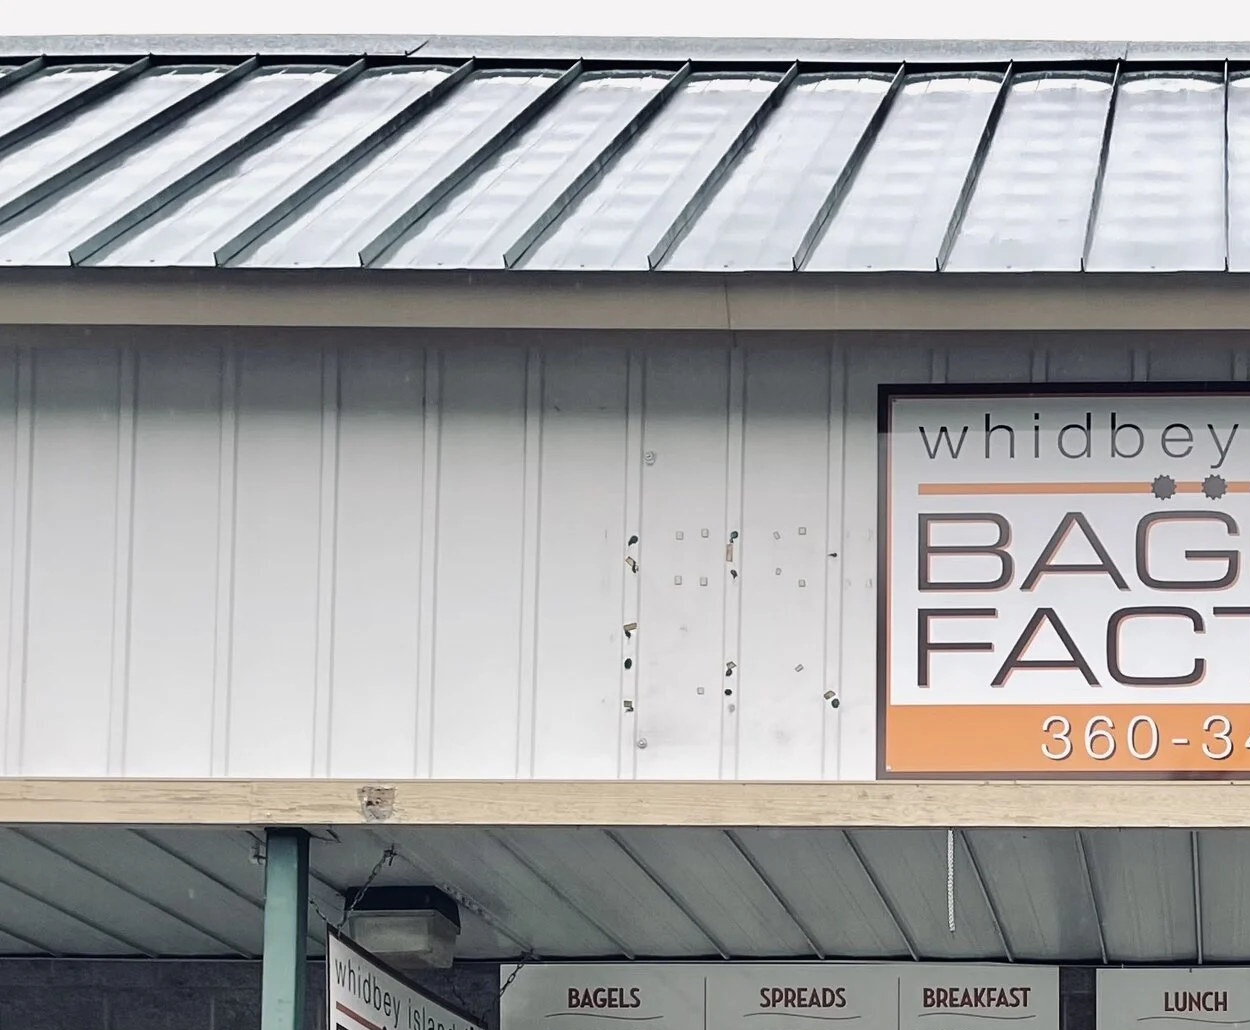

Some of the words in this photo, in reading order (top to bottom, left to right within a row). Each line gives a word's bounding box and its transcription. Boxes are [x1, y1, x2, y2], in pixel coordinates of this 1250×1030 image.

[919, 412, 1240, 469] whidbey
[335, 957, 400, 1028] whidbey
[568, 988, 641, 1008] BAGELS
[760, 988, 847, 1008] SPREADS
[923, 988, 1031, 1008] BREAKFAST
[1165, 991, 1227, 1012] LUNCH
